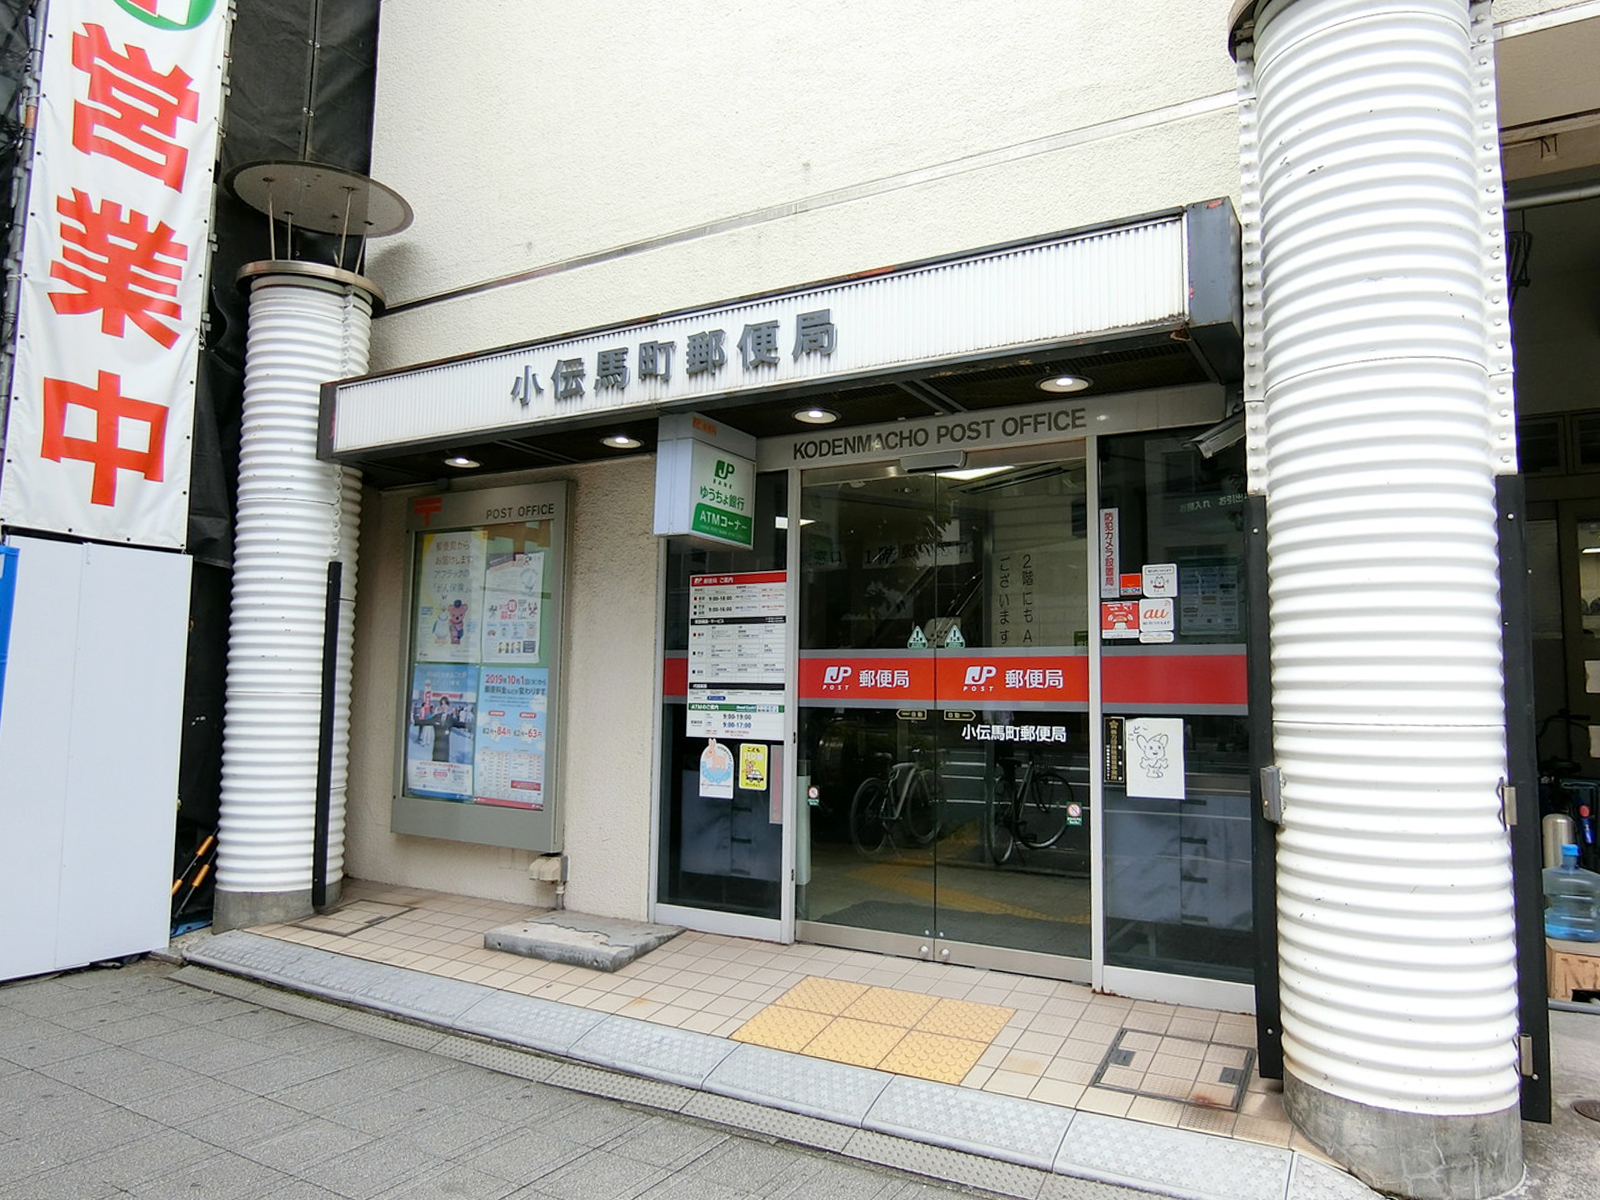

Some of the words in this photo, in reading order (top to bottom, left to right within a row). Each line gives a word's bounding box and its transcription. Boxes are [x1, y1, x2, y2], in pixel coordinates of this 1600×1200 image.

[41, 22, 199, 507] 営業中
[510, 308, 838, 405] 小伝馬町郵便局
[793, 427, 929, 461] KODENMACHO
[936, 419, 995, 445] POST
[1001, 407, 1087, 438] OFFICE
[713, 479, 733, 489] BANK
[700, 485, 745, 511] ゆうちょ銀行
[486, 507, 513, 519] POST
[518, 503, 555, 517] OFFICE
[700, 510, 748, 530] ATMコーナー
[1143, 608, 1169, 619] au
[859, 669, 910, 688] 郵便局
[1005, 669, 1064, 689] 郵便局
[961, 723, 1067, 743] 小伝馬町郵便局
